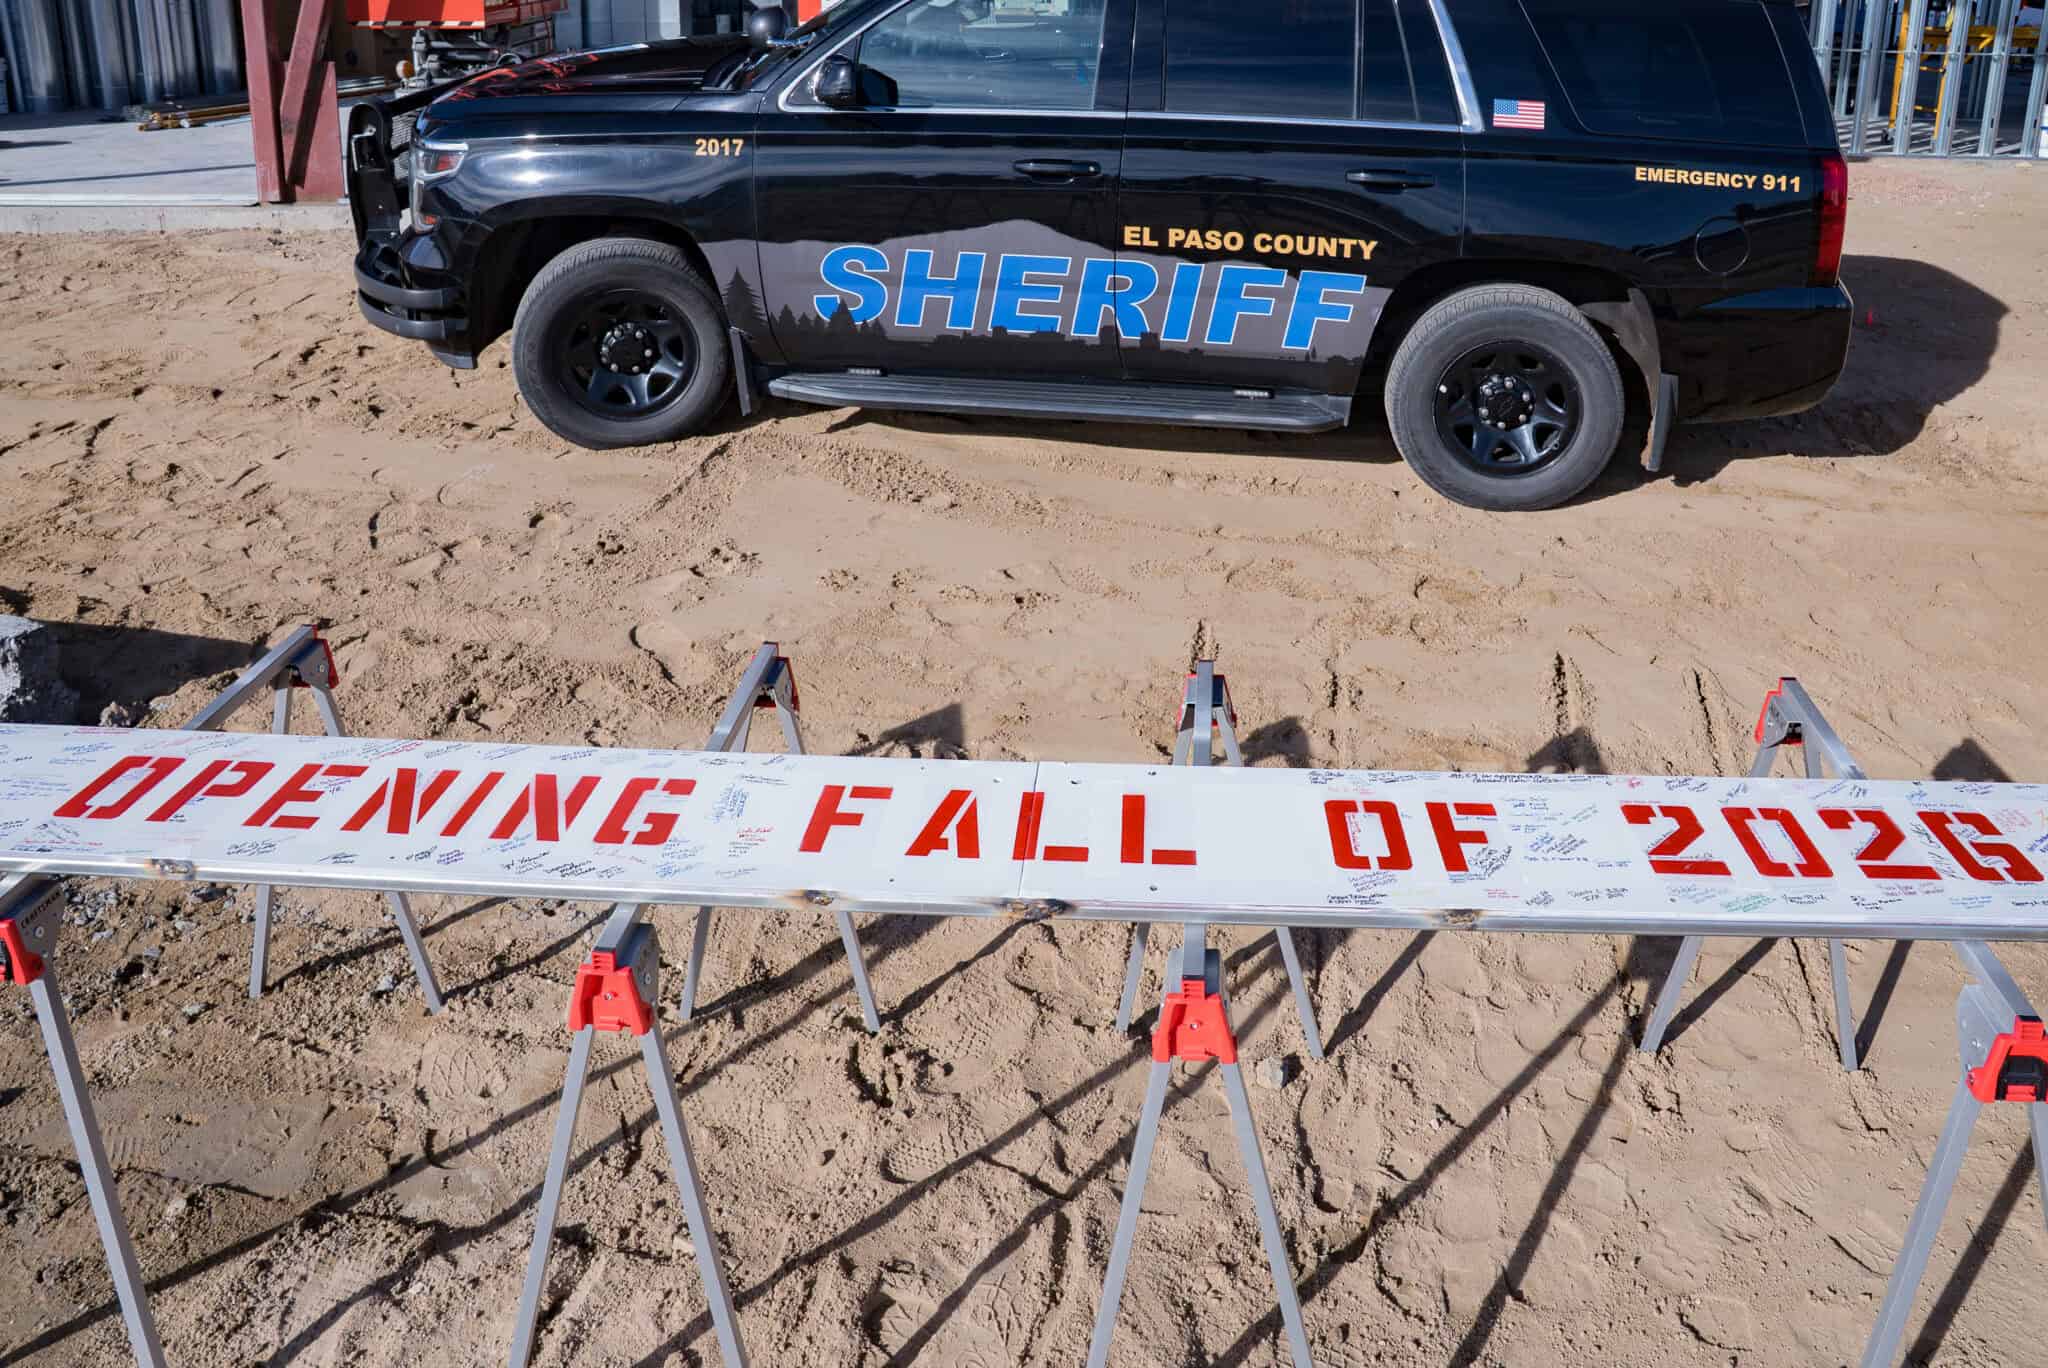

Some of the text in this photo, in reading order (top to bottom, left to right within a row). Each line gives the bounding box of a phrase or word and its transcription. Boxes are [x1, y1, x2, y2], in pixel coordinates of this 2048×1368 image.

[695, 138, 744, 157] 2017
[1635, 167, 1801, 192] EMERGENCY 911
[1123, 225, 1378, 260] EL PASO COUNTY
[813, 245, 1367, 350] SHERIFF
[53, 755, 697, 846] OPENING
[798, 784, 1197, 865] FALL
[1324, 800, 1497, 872] OF
[1619, 804, 2046, 882] 2026
